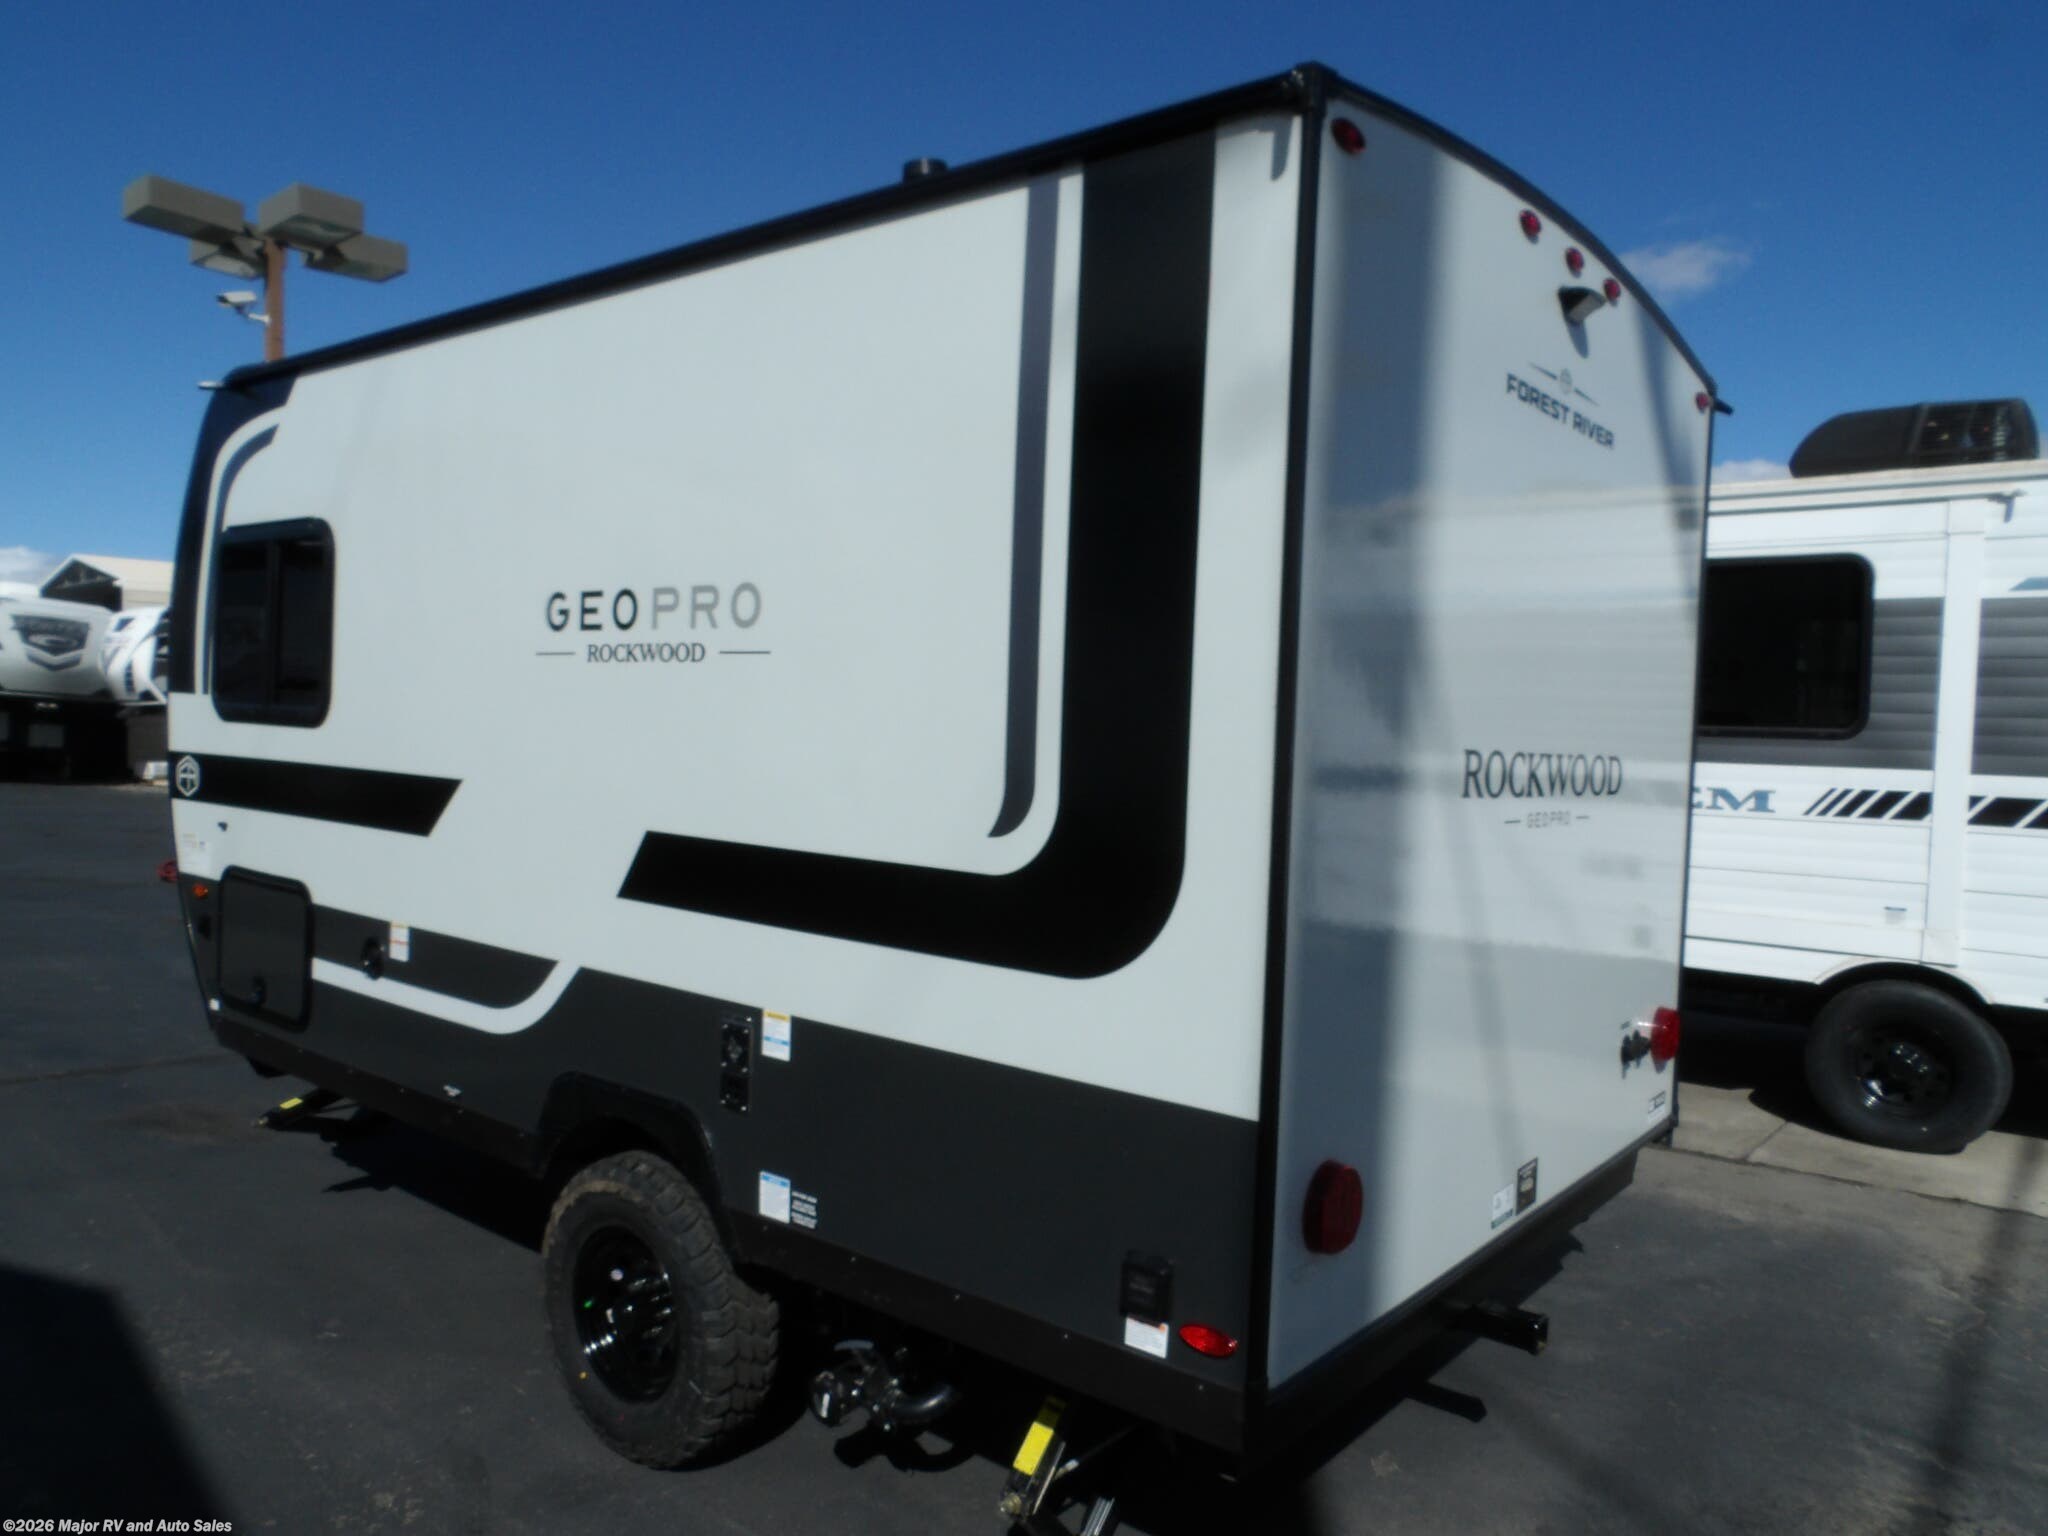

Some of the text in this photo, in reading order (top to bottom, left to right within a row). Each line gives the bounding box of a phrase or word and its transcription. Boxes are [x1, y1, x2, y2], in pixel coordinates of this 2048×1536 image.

[1506, 372, 1615, 450] FOREST RIVER
[587, 642, 706, 663] ROCKWOOD
[1462, 749, 1622, 798] ROCKWOOD
